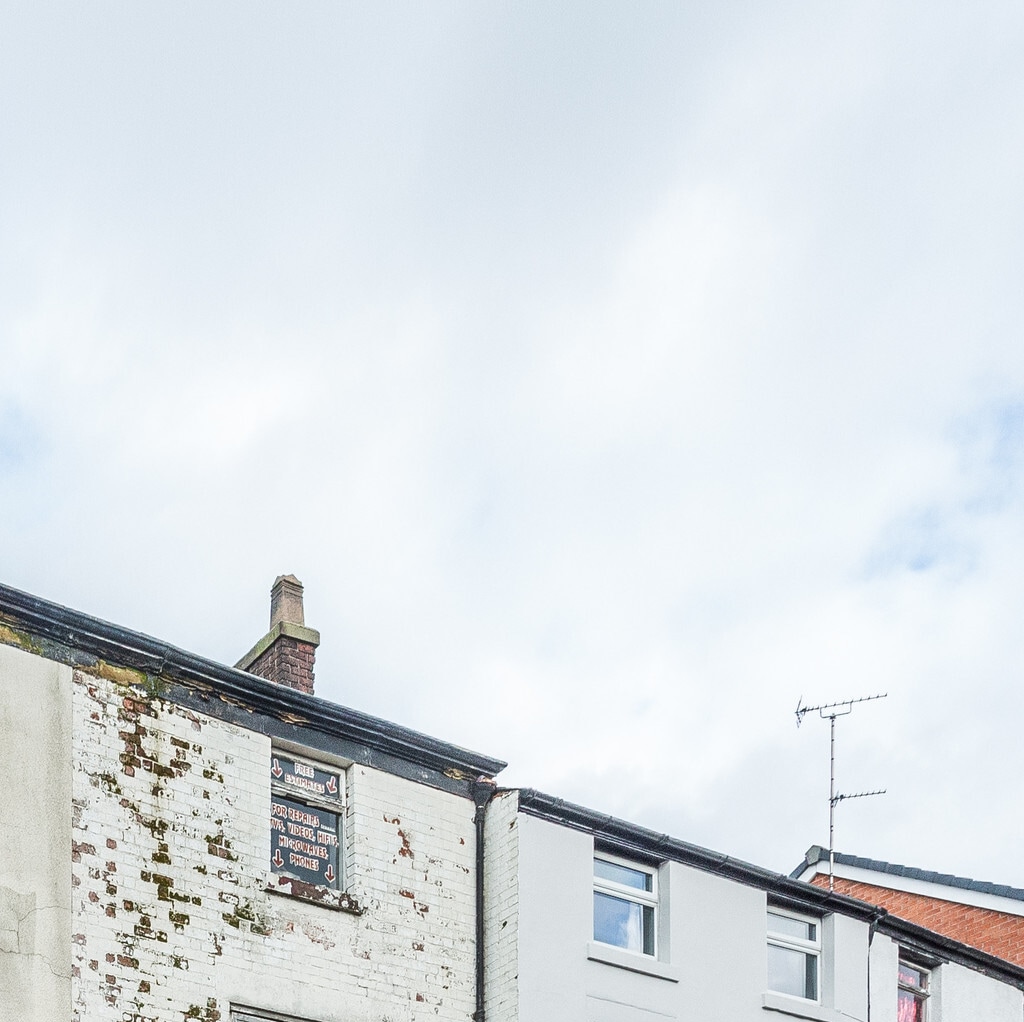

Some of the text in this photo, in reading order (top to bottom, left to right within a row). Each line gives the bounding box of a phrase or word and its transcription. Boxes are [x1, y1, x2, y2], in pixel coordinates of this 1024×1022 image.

[295, 763, 314, 777] FREE
[284, 774, 325, 793] ESTIMATES
[272, 803, 320, 827] FOR REPAIRS
[289, 853, 319, 871] PHONES
